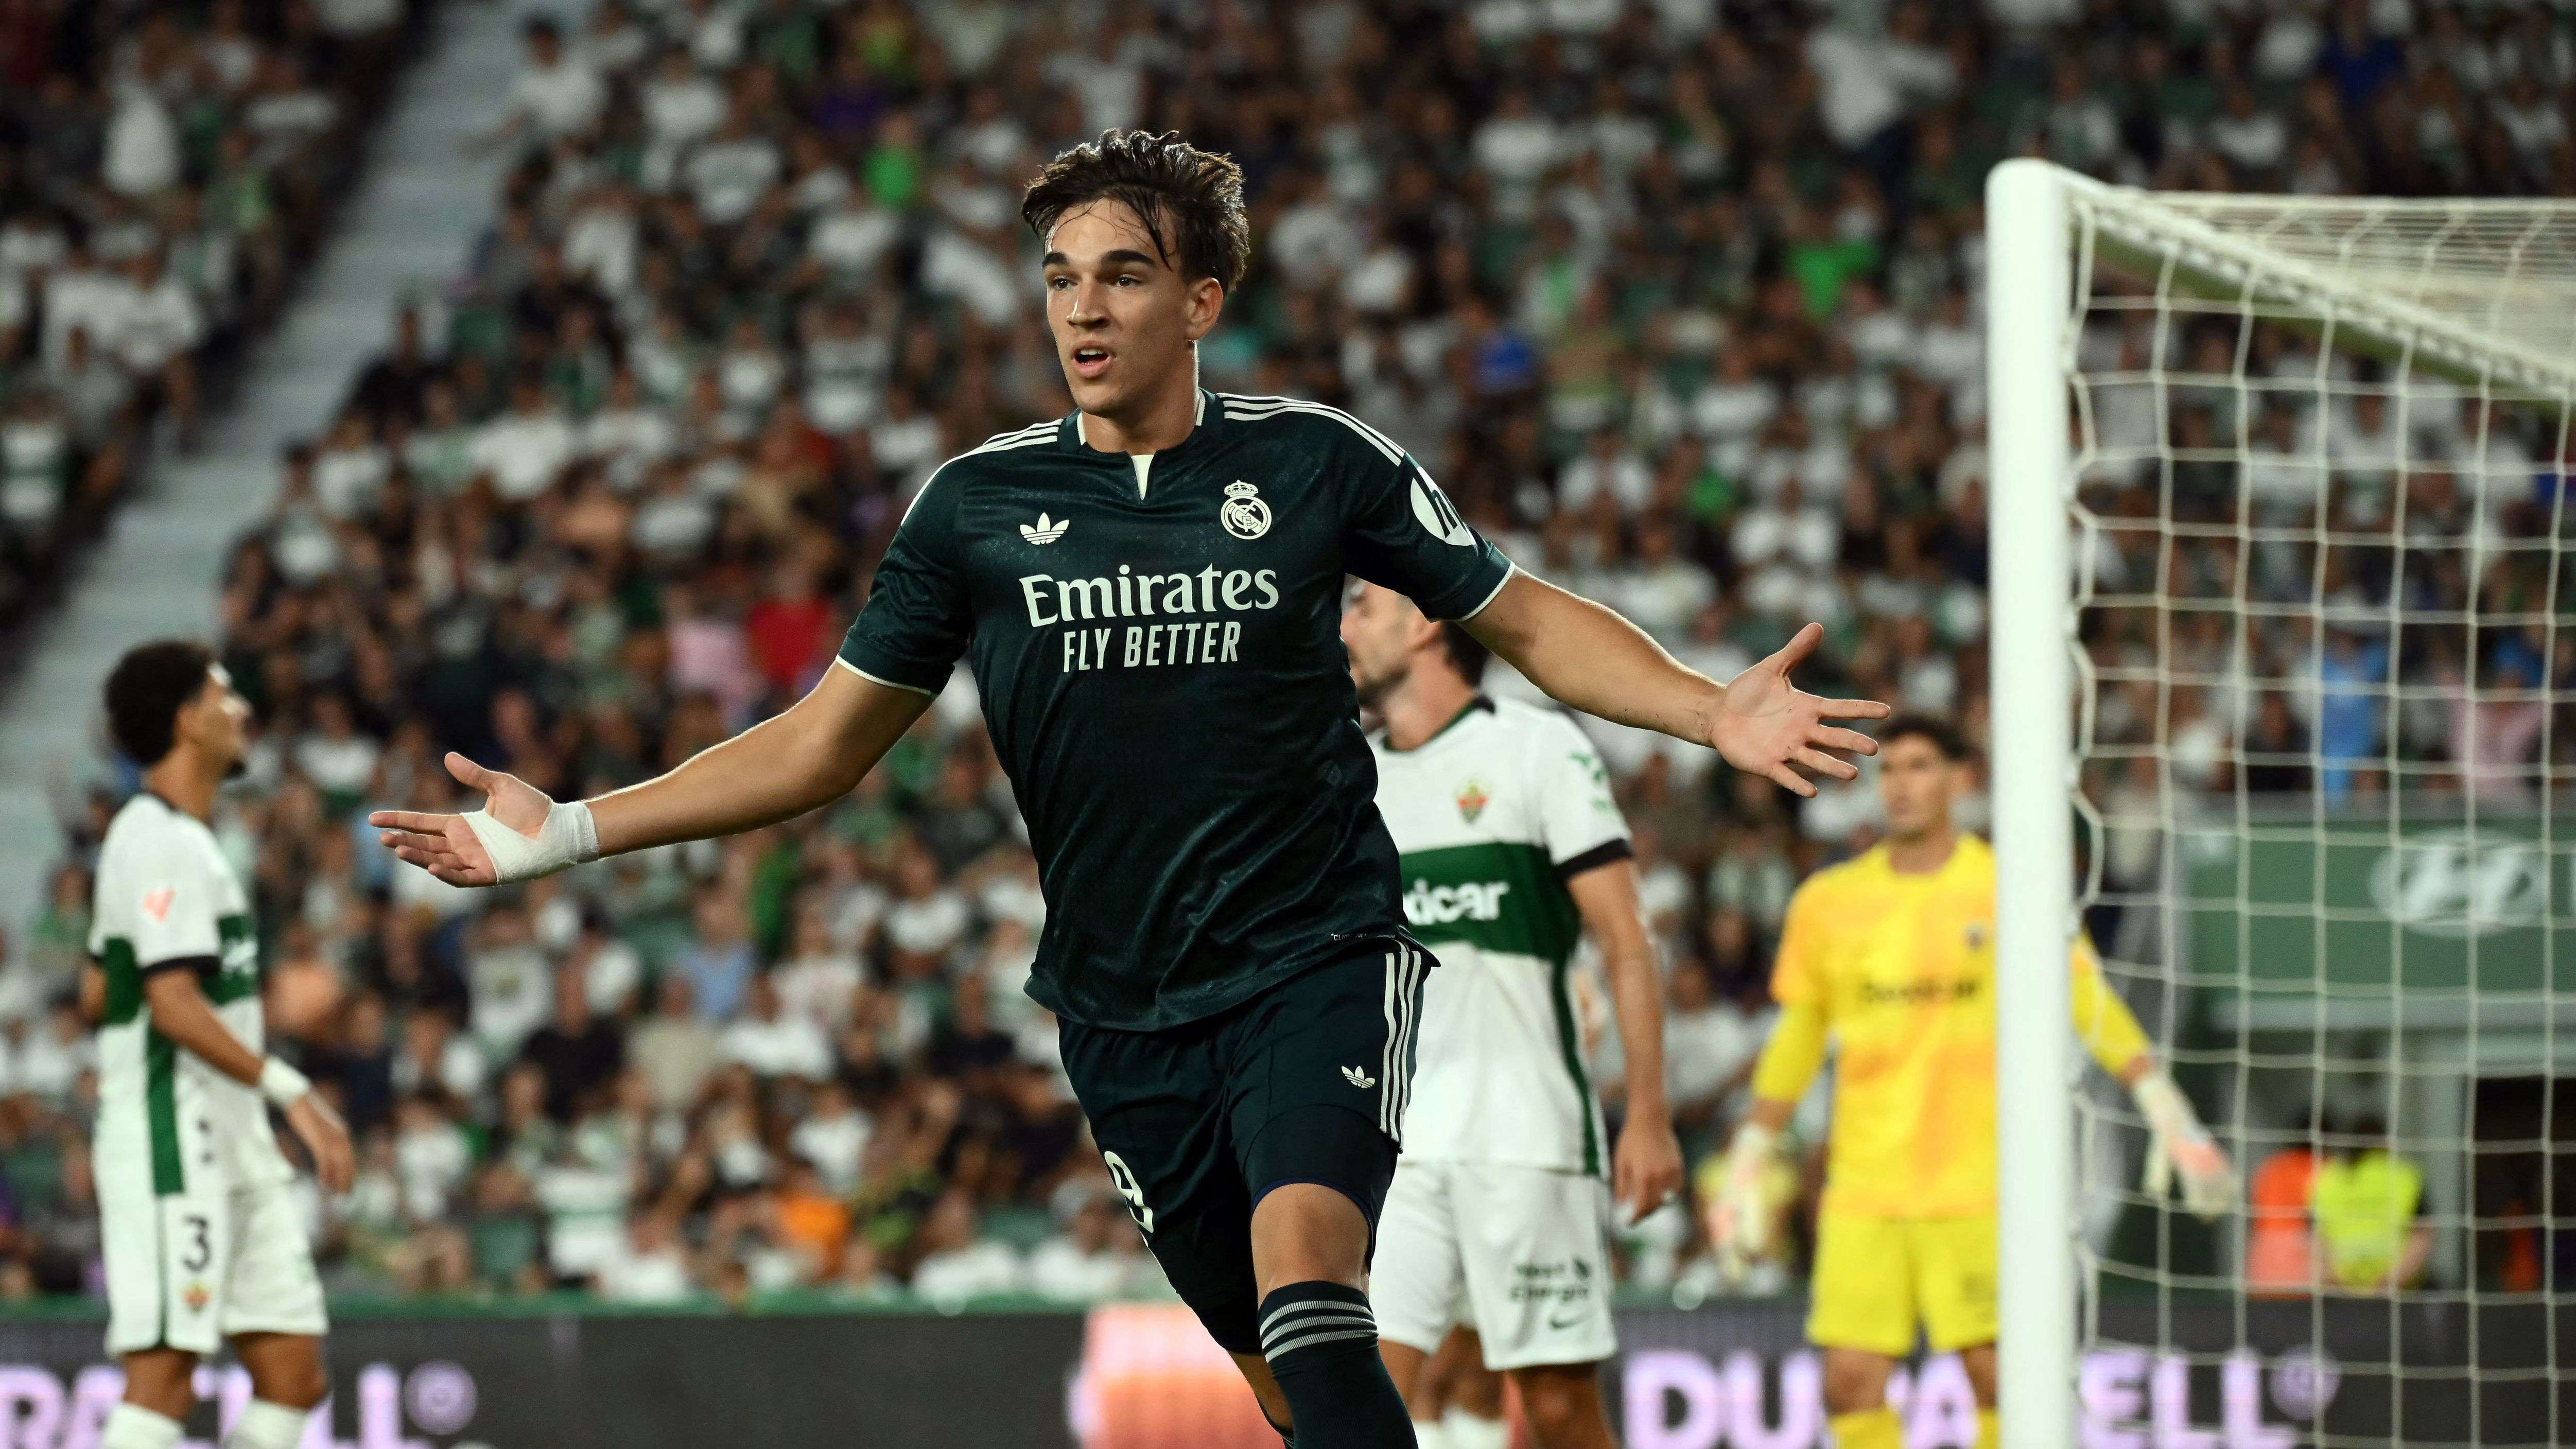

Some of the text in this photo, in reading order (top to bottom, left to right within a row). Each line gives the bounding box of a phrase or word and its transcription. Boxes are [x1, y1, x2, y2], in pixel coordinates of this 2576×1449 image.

[1019, 563, 1279, 627] Emirates
[1063, 621, 1242, 673] FLY BETTER
[183, 1214, 211, 1272] 3
